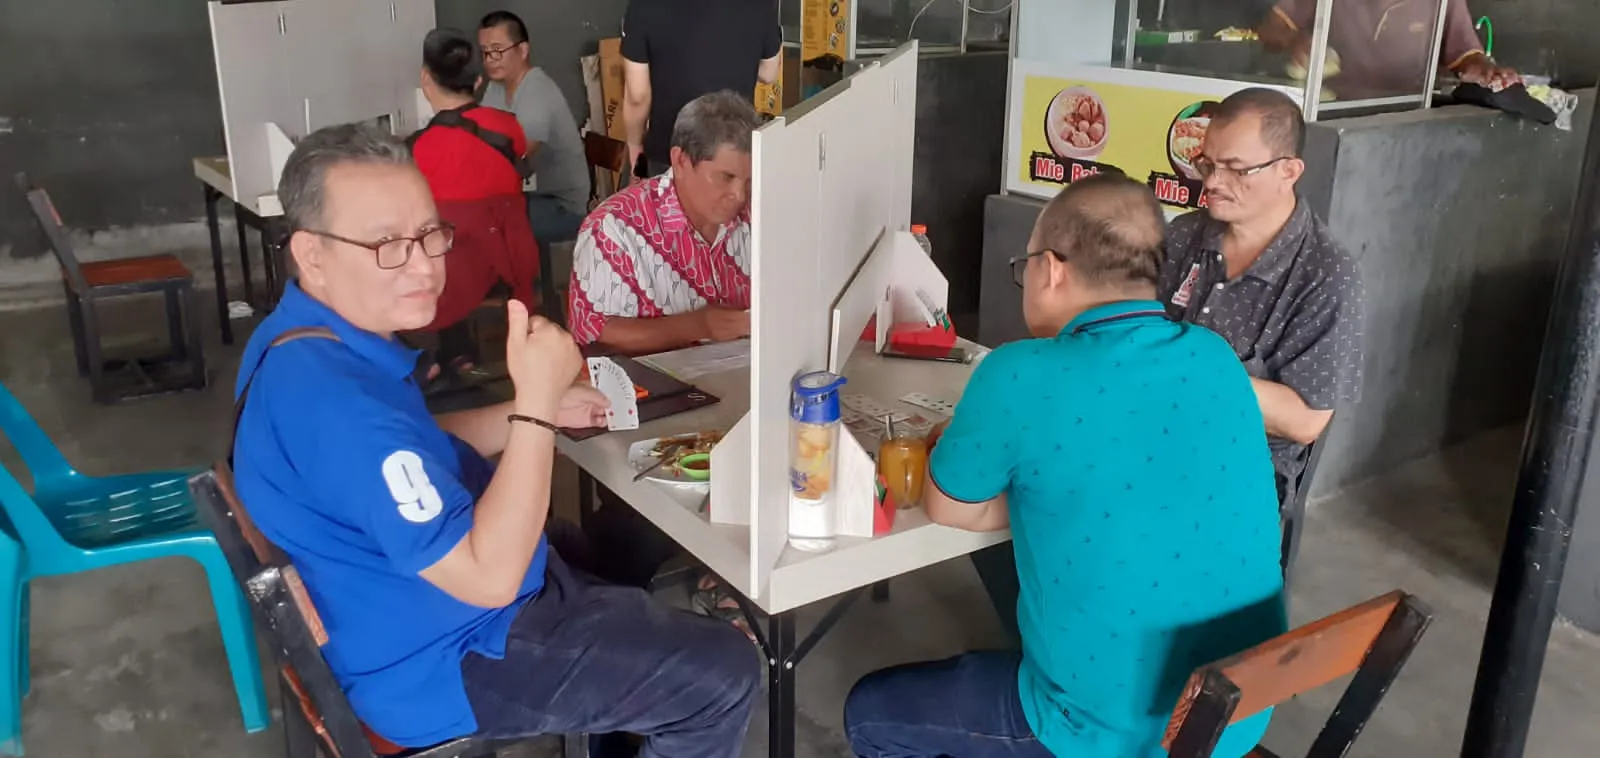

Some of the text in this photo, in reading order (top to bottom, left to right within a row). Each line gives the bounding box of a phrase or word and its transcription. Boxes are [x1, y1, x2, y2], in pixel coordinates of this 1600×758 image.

[1036, 157, 1063, 180] Mie
[1155, 178, 1189, 202] Mie
[382, 450, 443, 523] 9
